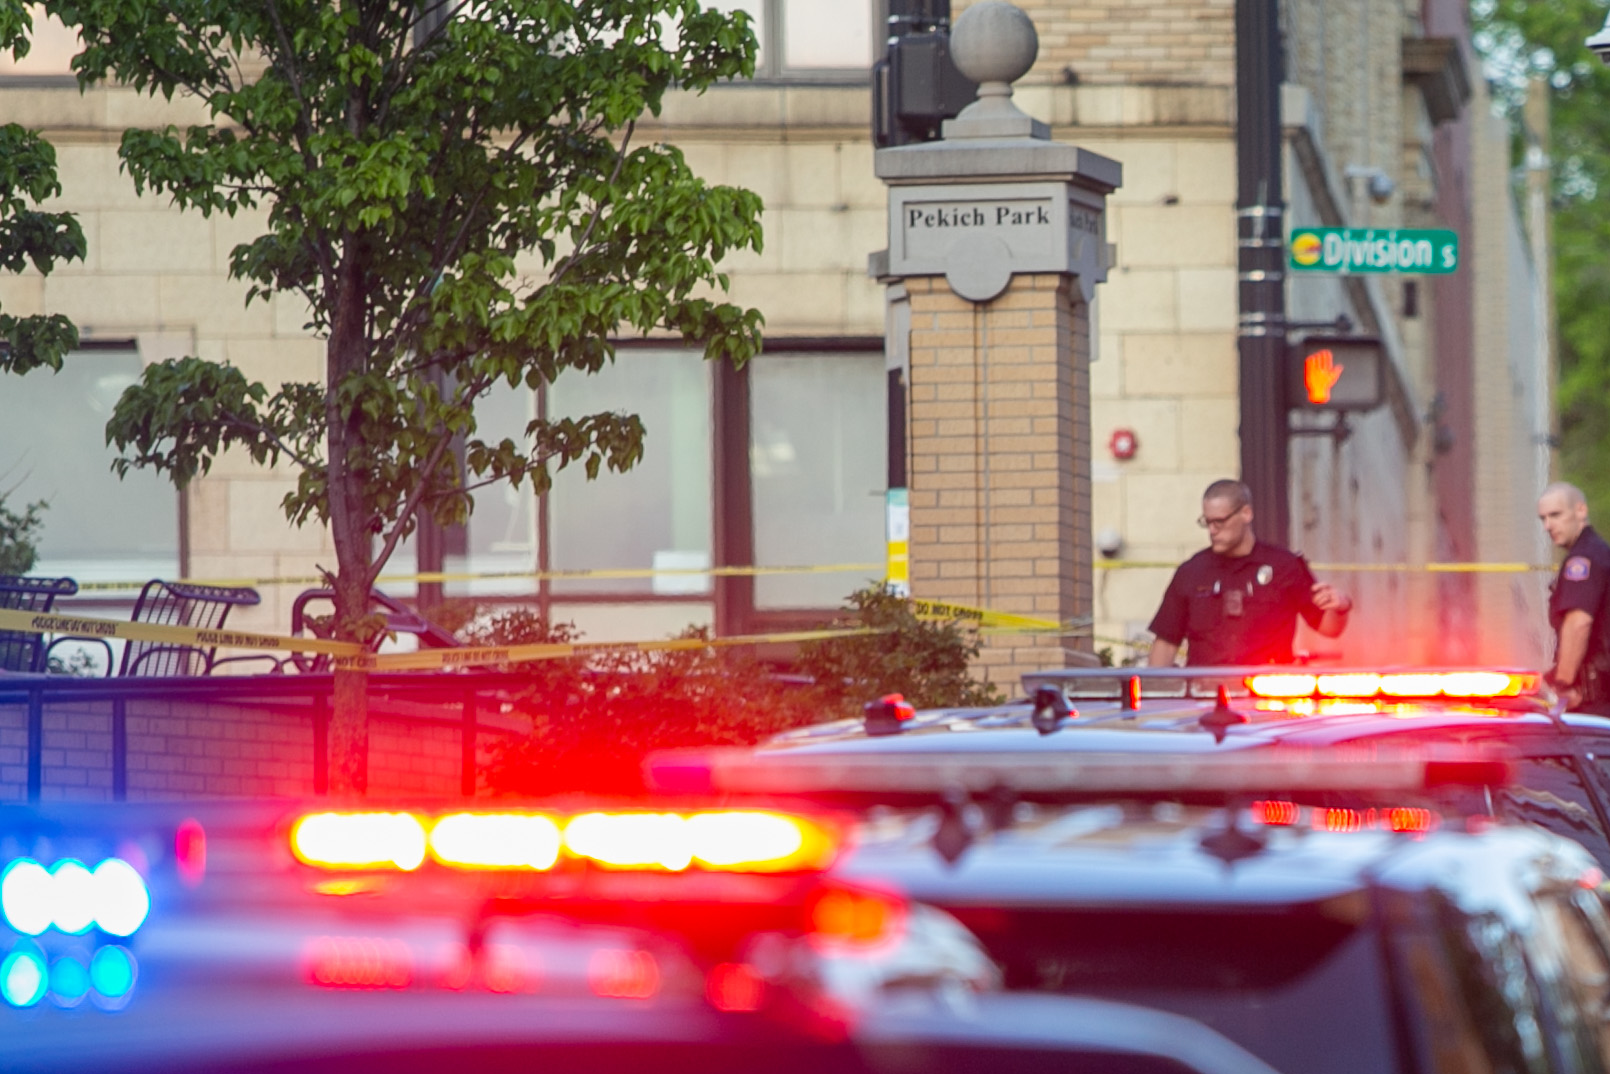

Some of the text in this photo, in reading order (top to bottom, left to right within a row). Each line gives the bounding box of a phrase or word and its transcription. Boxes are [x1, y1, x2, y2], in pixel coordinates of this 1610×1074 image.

[909, 208, 985, 228] Pekich
[996, 206, 1050, 226] Park
[1322, 231, 1433, 269] Division
[917, 602, 929, 615] DO
[932, 603, 951, 616] NOT
